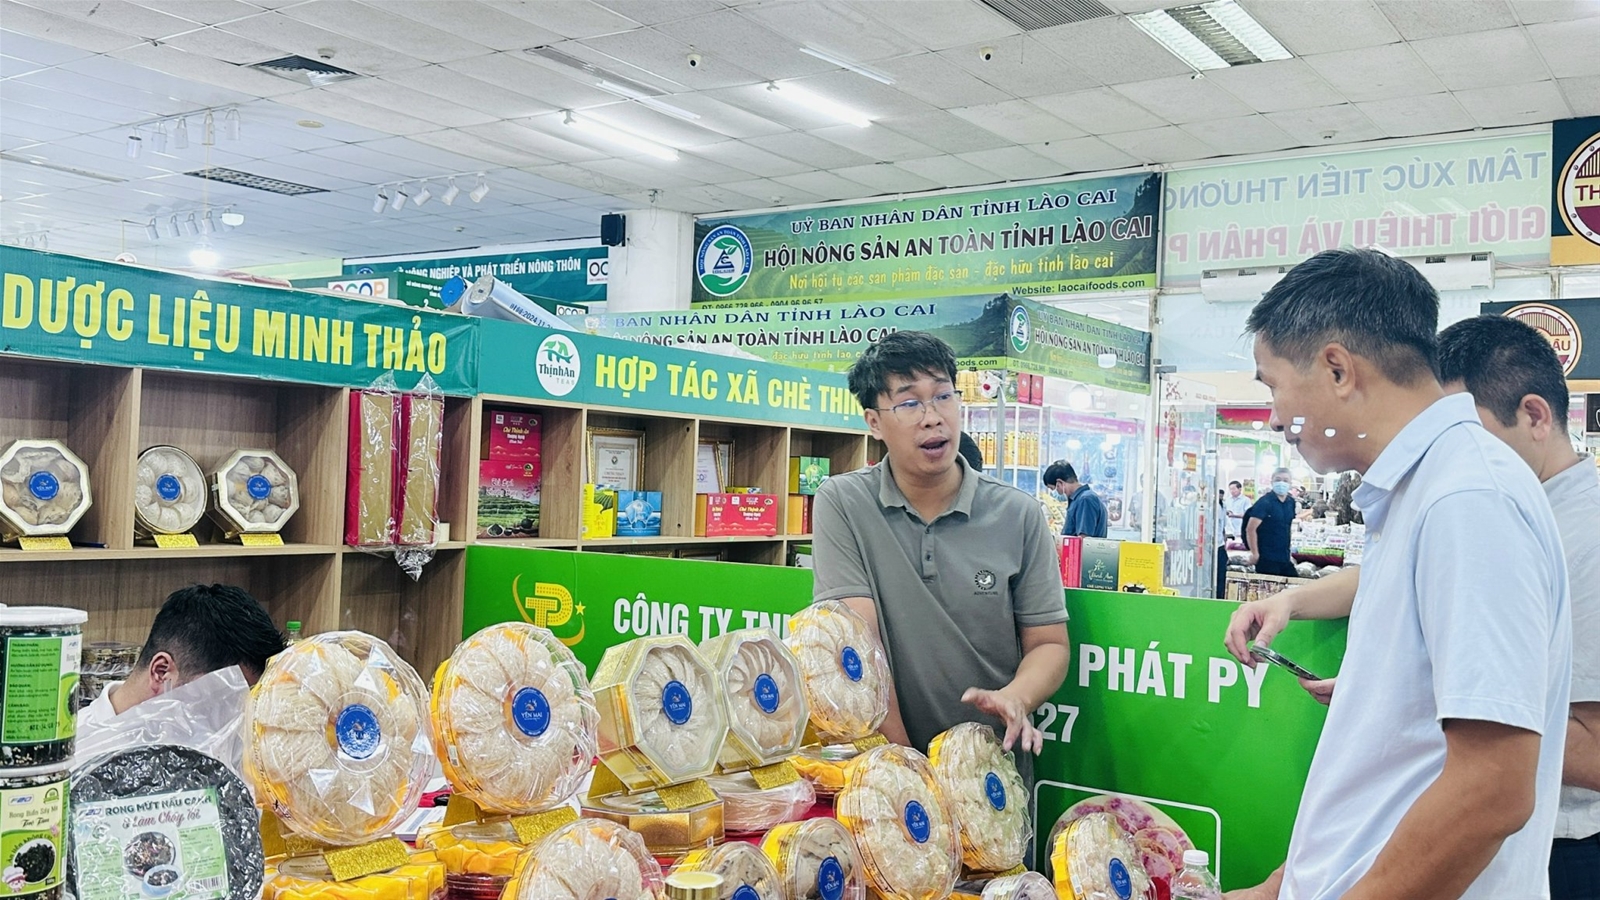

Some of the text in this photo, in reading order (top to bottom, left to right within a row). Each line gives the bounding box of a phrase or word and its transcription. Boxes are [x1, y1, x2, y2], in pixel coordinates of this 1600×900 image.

[819, 217, 854, 231] BAN
[861, 210, 915, 228] NHÂN
[923, 205, 963, 222] DÂN
[970, 199, 1019, 217] TỈNH
[1028, 193, 1069, 211] LÀO
[1078, 190, 1116, 206] CAI
[764, 216, 1152, 271] HỘI NÔNG SẢN AN TOÀN TỈNH LÀO CAI
[461, 263, 473, 278] VÀ
[475, 261, 498, 278] PHÁT
[499, 257, 526, 275] TRIỂN
[527, 260, 554, 273] NÔNG
[556, 257, 581, 270] THÔN
[811, 273, 827, 291] hội
[985, 260, 1005, 281] đặc
[1070, 252, 1088, 271] lào
[1094, 251, 1113, 269] cai
[1012, 279, 1145, 296] Website: laocaifoods.com
[2, 273, 447, 375] DƯỢC LIỆU MINH THẢO
[615, 303, 937, 328] BAN NHÂN DÂN TỈNH LÀO CAI
[737, 328, 780, 347] TOÀN
[784, 323, 824, 345] TỈNH
[830, 325, 863, 344] LÀO
[867, 327, 897, 344] CA
[595, 353, 658, 398] HỢP
[667, 361, 718, 400] TÁC
[727, 369, 760, 406] XÃ
[767, 374, 811, 411] CHÈ
[613, 593, 690, 636] CÔNG
[699, 606, 733, 642] TY
[1078, 640, 1270, 709] PHÁT PY
[1028, 702, 1080, 743] 27
[105, 804, 135, 817] RONG
